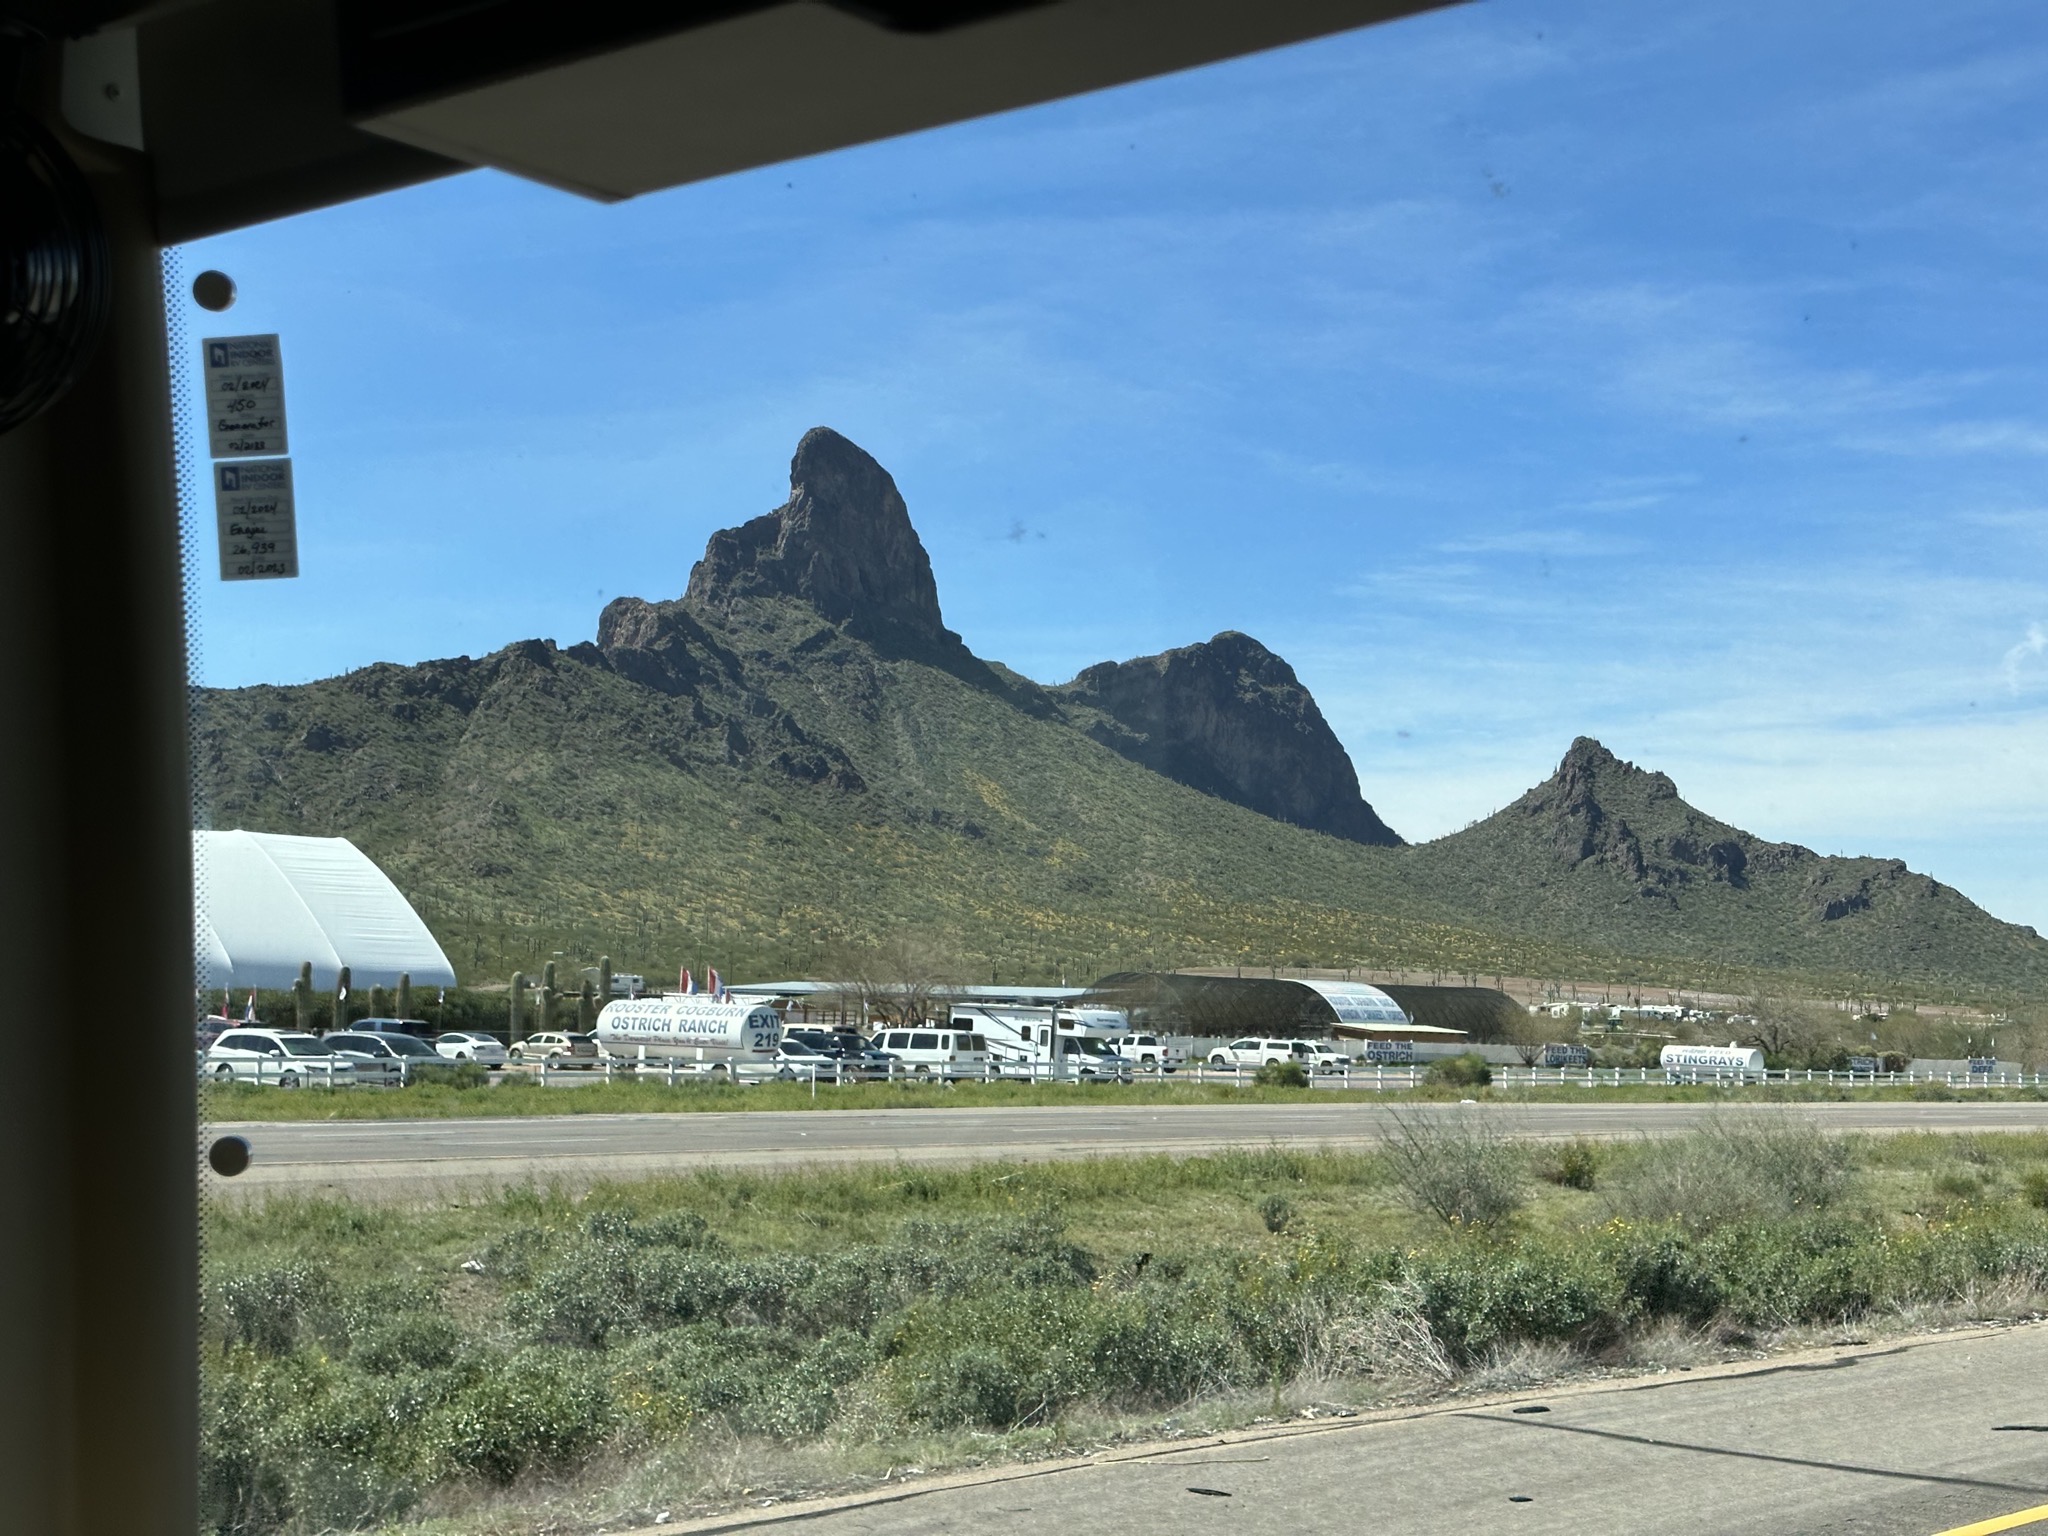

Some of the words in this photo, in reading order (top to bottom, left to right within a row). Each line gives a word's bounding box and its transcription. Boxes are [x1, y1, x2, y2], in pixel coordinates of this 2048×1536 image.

[241, 473, 285, 483] INDOOR
[605, 1003, 673, 1015] ROOSTER
[676, 1005, 750, 1018] COGBURN
[611, 1016, 673, 1033] OSTRICH
[678, 1018, 729, 1034] RANCH
[749, 1014, 780, 1029] EXIT
[753, 1032, 780, 1048] 219
[1367, 1041, 1392, 1050] FEED
[1395, 1042, 1413, 1050] THE
[1367, 1050, 1413, 1061] OSTRICH
[1546, 1046, 1568, 1054] FEED
[1571, 1046, 1588, 1054] THE
[1666, 1054, 1744, 1066] STINGRAYS
